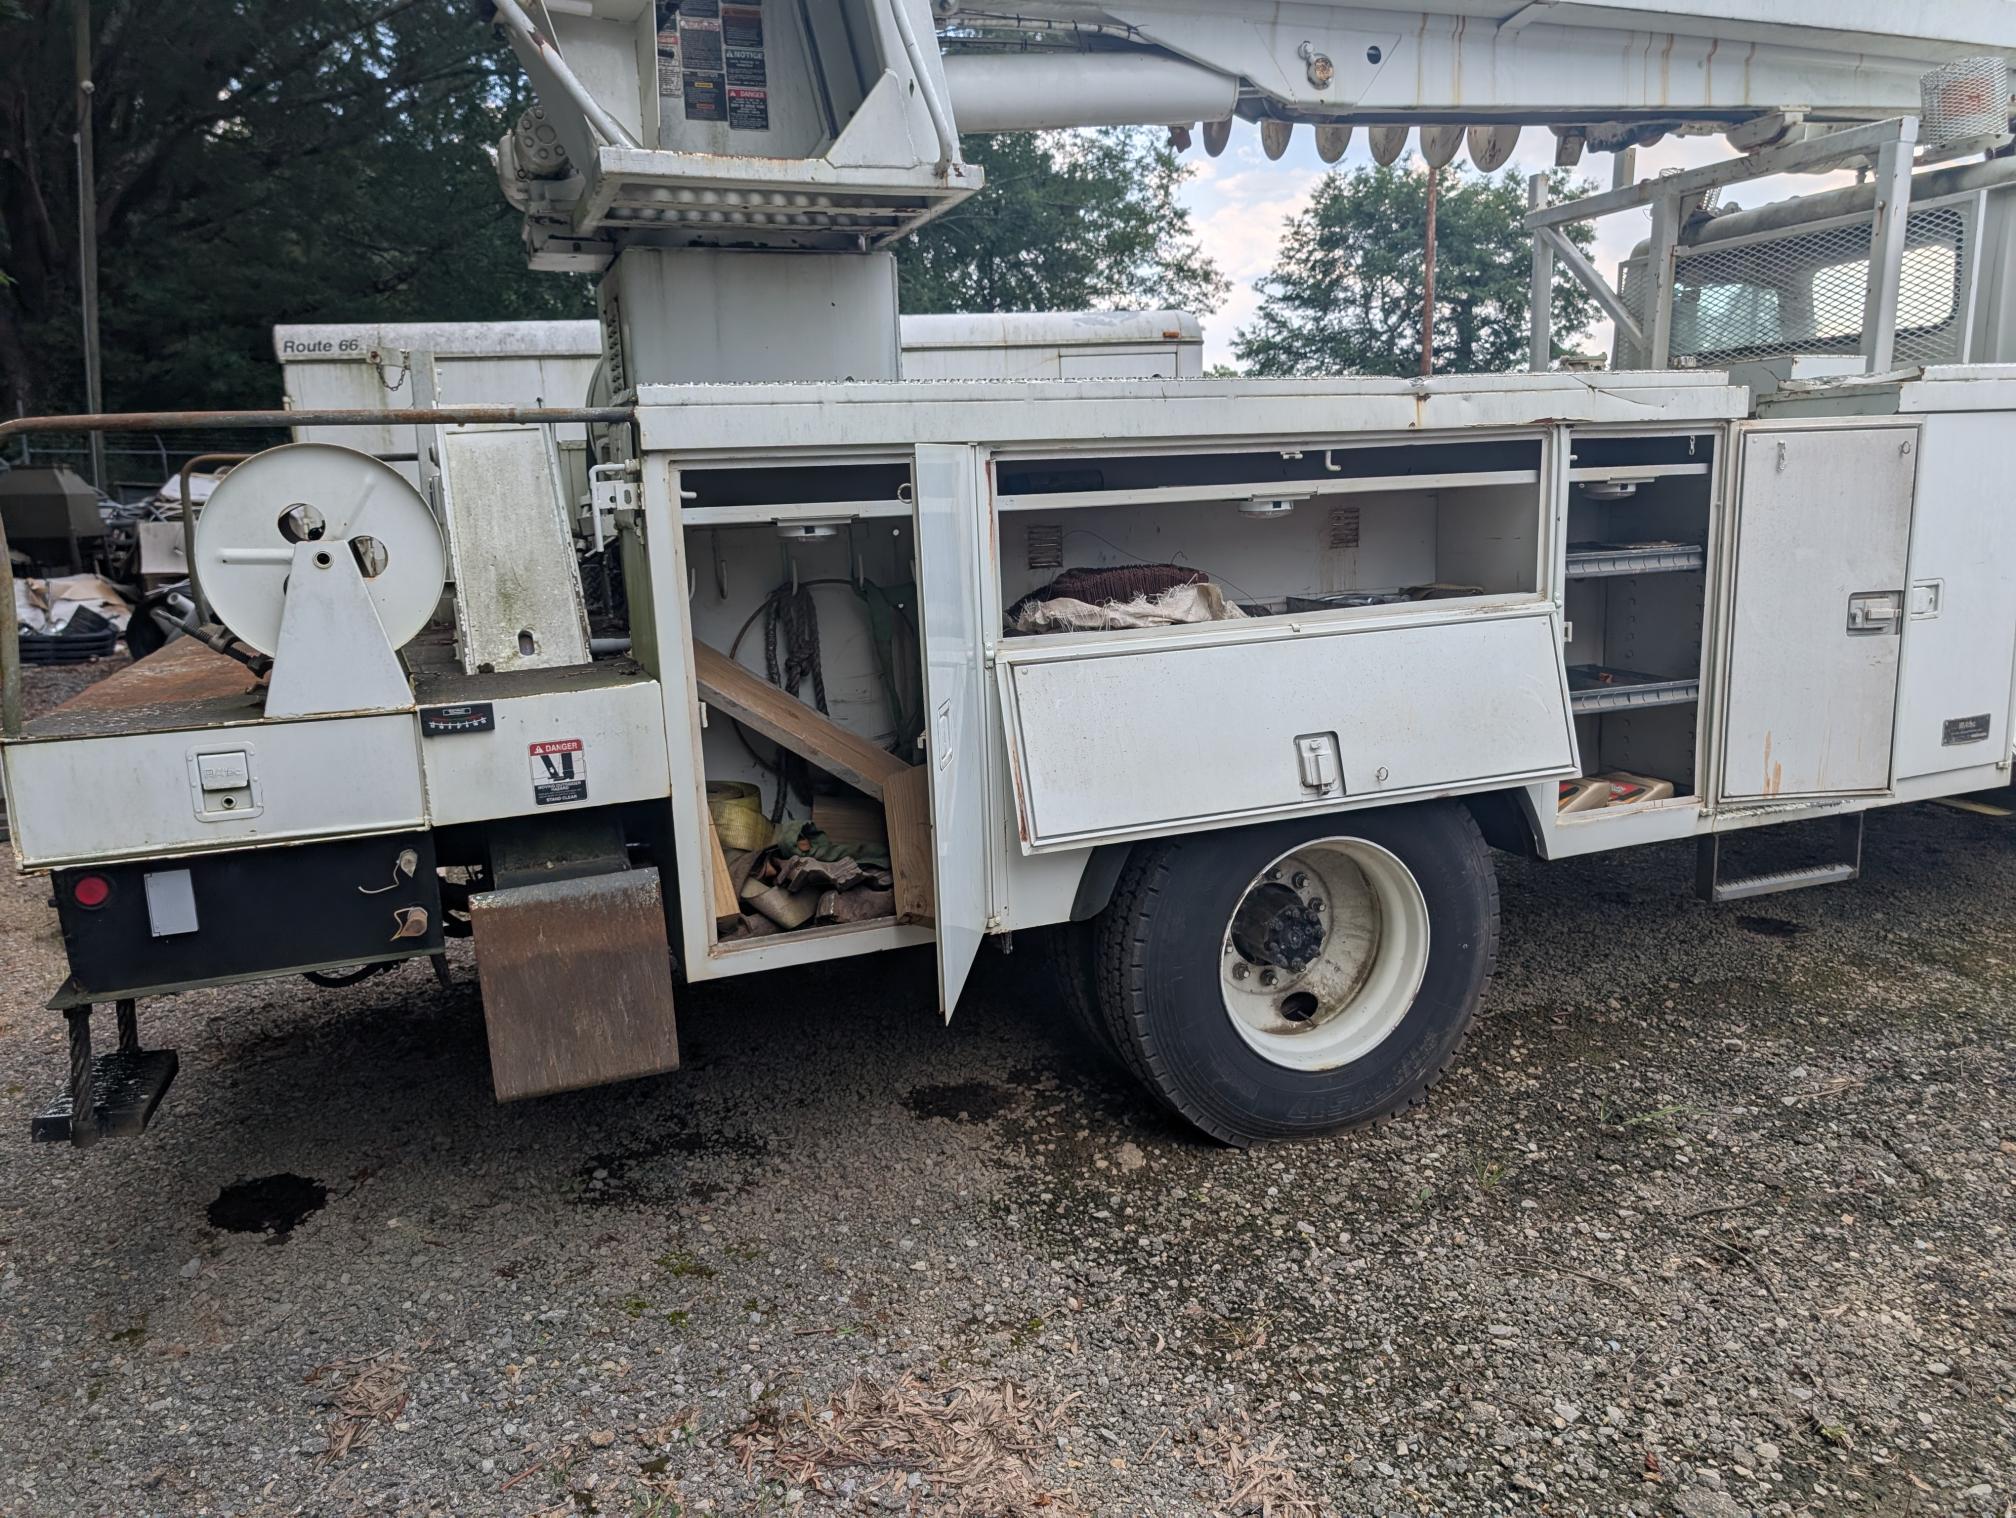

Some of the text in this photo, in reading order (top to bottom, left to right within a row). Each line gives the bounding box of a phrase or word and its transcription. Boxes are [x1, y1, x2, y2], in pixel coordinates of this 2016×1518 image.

[734, 51, 763, 59] NOTICE
[740, 90, 765, 98] DANGER
[284, 339, 359, 353] Route 66
[545, 742, 577, 752] DANGER
